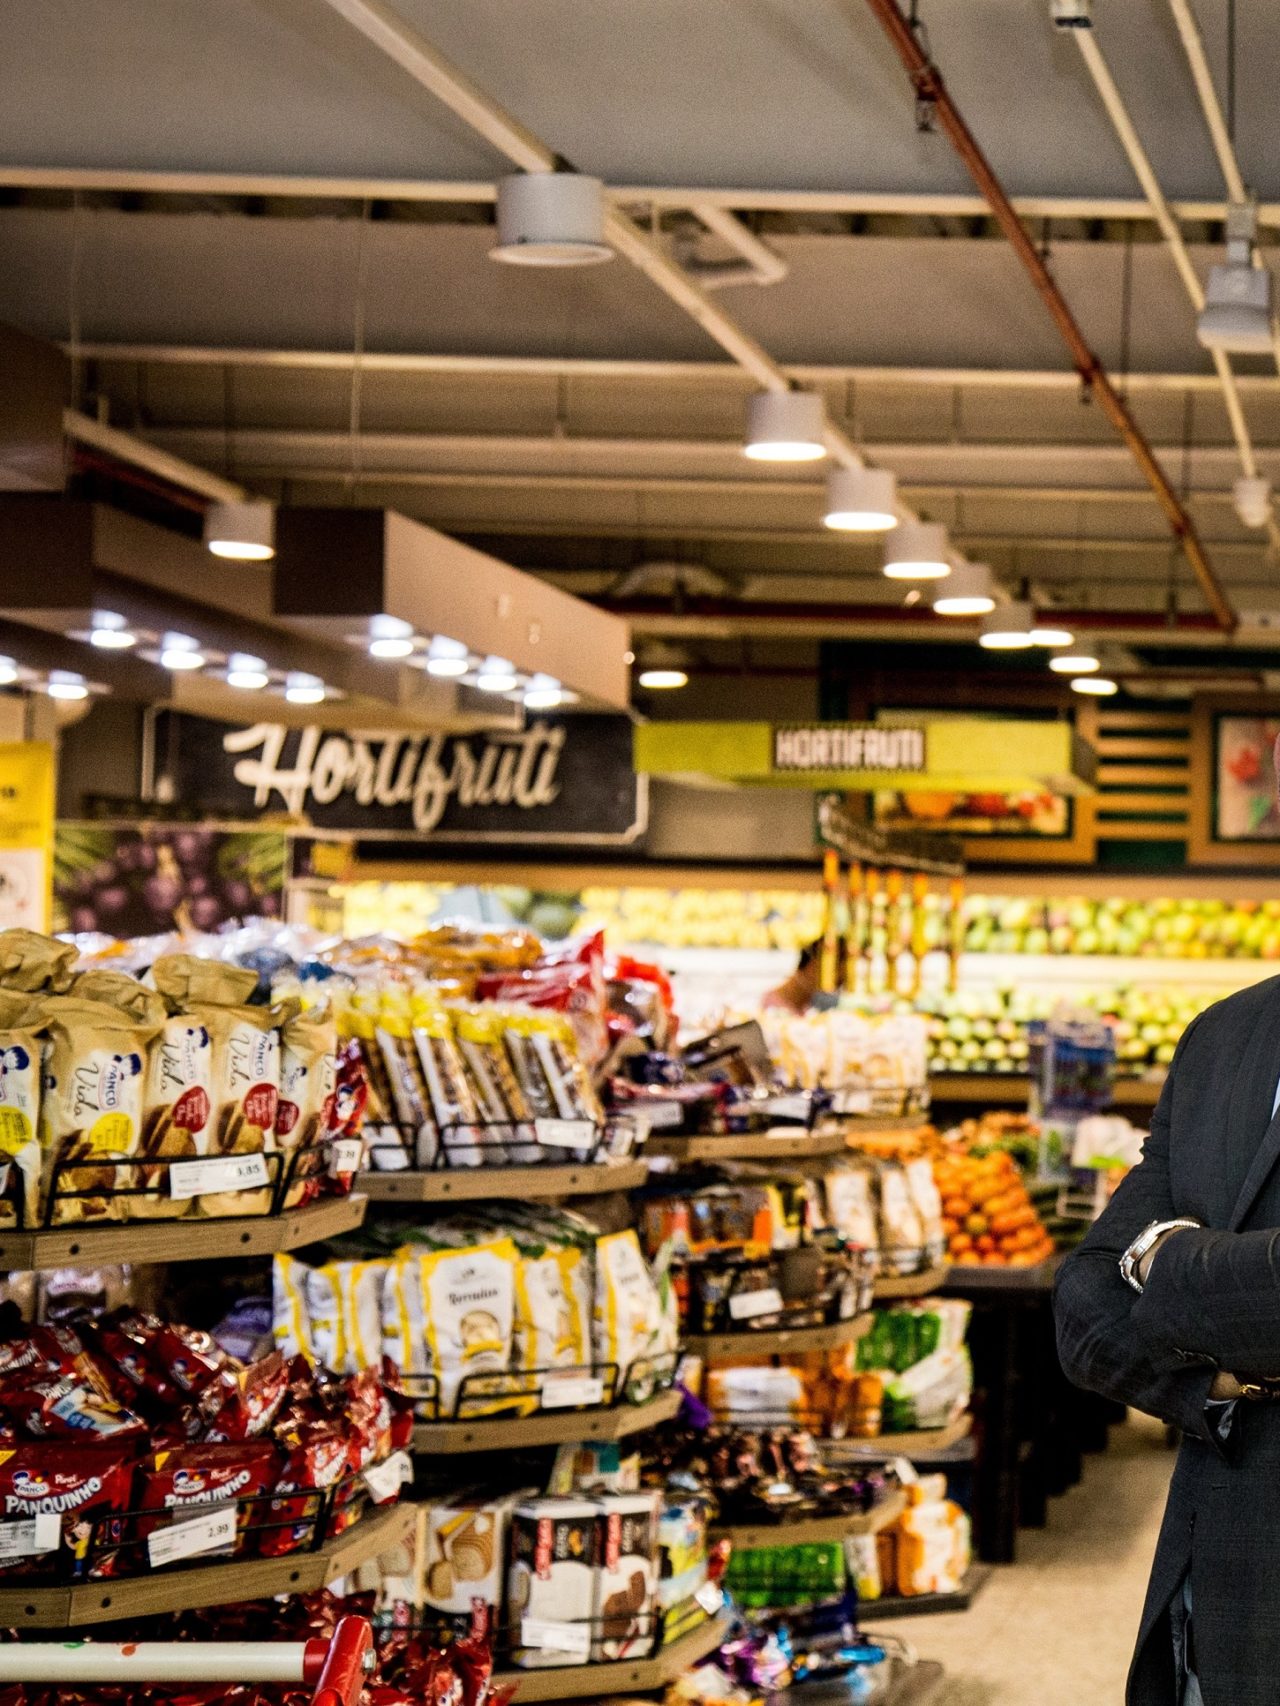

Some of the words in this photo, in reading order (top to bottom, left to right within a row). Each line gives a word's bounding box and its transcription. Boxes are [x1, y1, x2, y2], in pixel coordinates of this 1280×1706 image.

[776, 729, 924, 768] HORTIFRUTI
[223, 722, 566, 832] Hortifruti
[74, 1062, 99, 1117] Vida
[5, 1476, 102, 1515] PANQUINHO
[20, 1485, 46, 1493] PANCO
